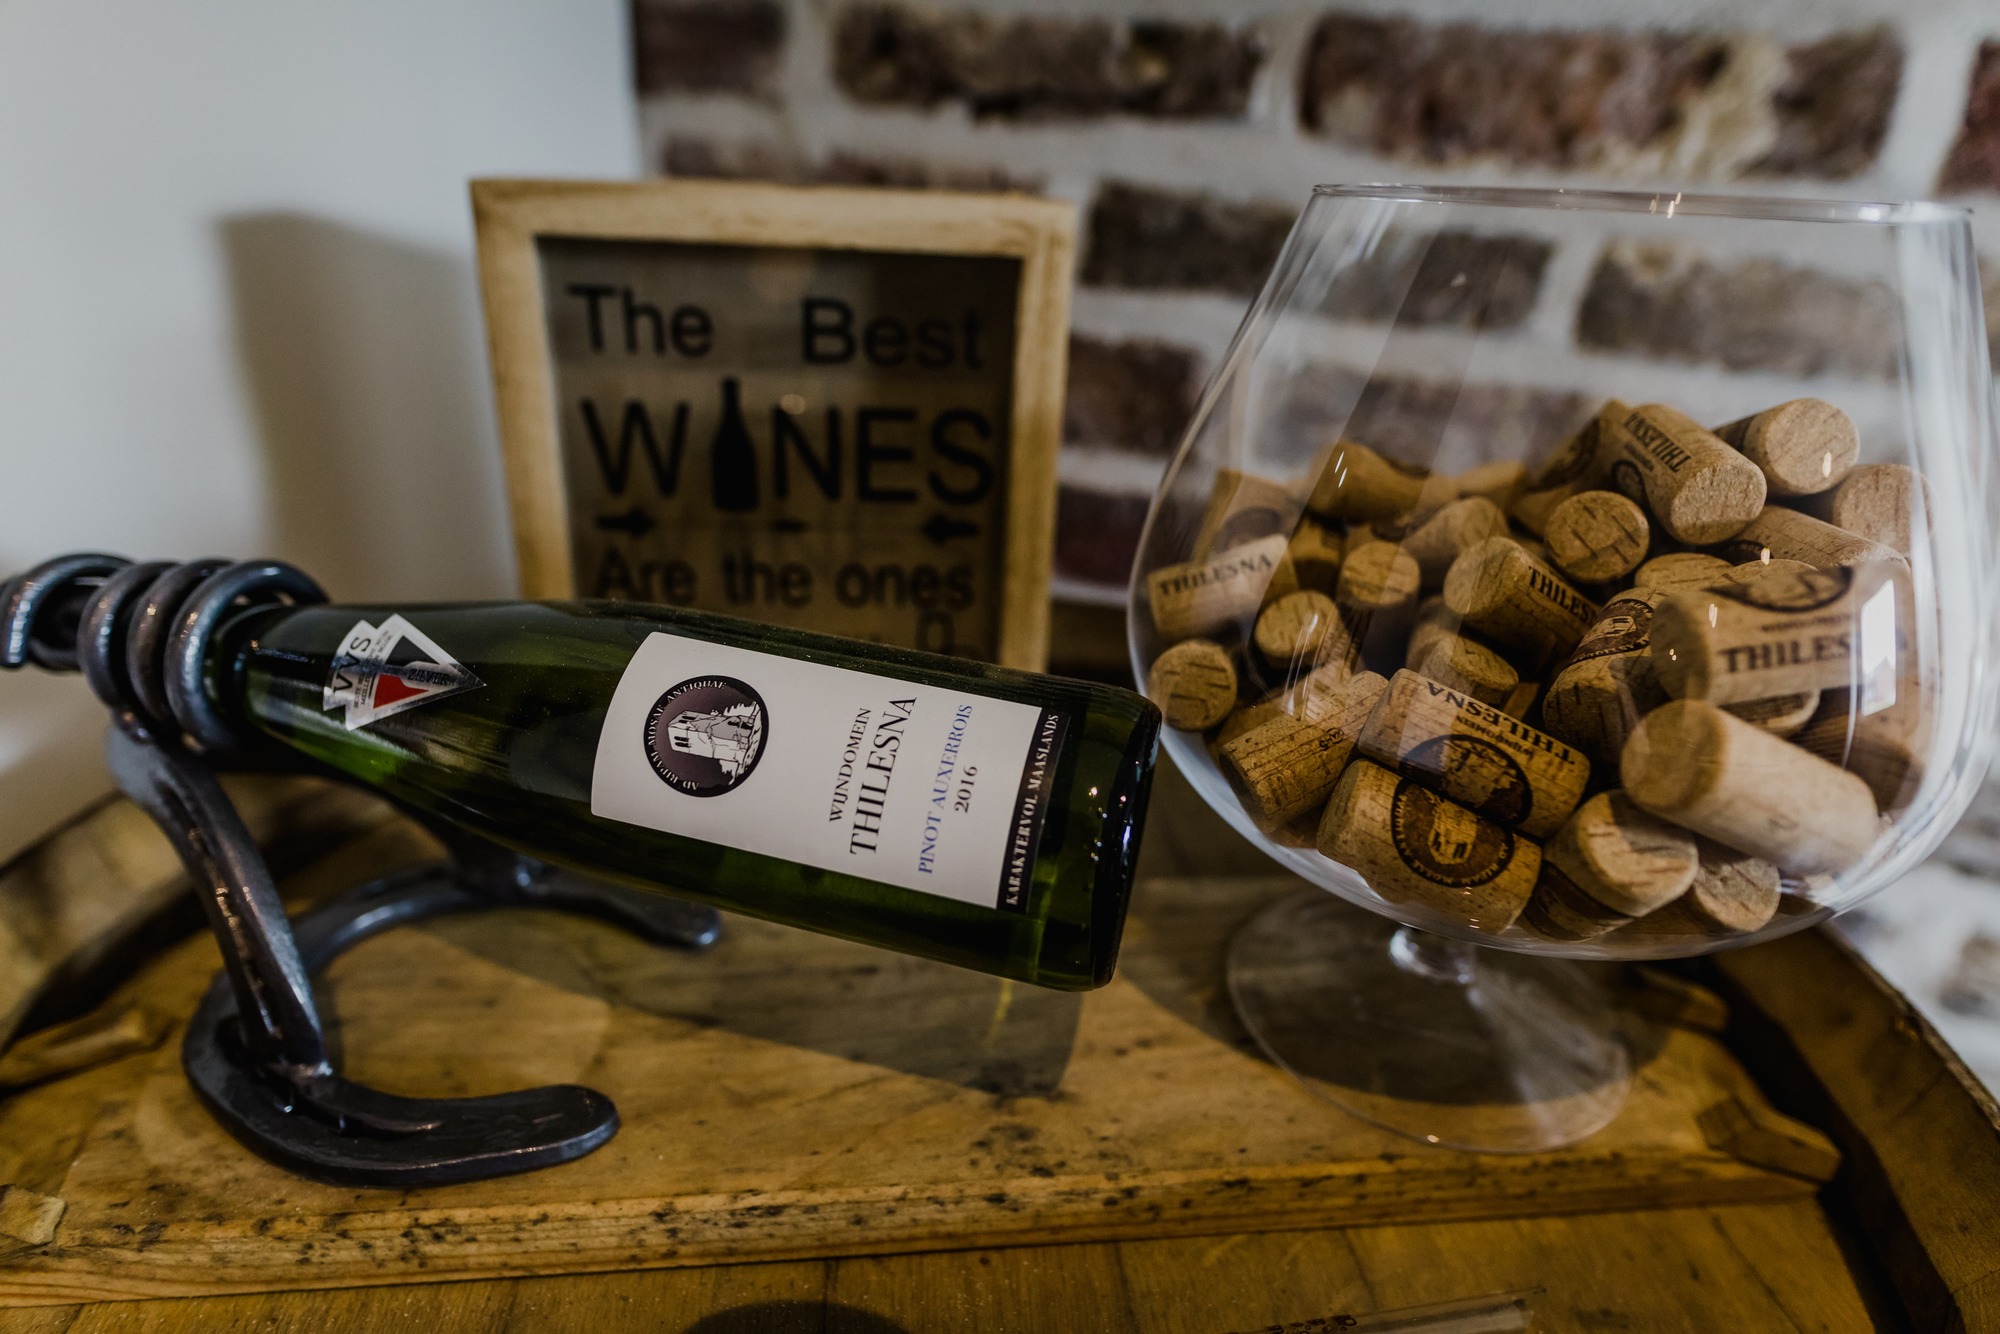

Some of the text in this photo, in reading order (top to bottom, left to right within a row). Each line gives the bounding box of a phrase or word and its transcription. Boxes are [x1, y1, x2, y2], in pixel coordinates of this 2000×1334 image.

[566, 284, 984, 370] The Best
[595, 547, 977, 611] Are the ones
[1528, 565, 1600, 627] THILES
[333, 636, 371, 693] VVS
[1716, 634, 1856, 674] THILES
[829, 707, 873, 823] WIJNDOMEIN
[1425, 680, 1576, 765] THILESNA
[849, 696, 917, 856] THILESNA
[917, 703, 973, 876] PINOT AUXERROIS
[954, 765, 978, 814] 2016
[1005, 713, 1060, 906] KARAKTERVOL MAASLANDS
